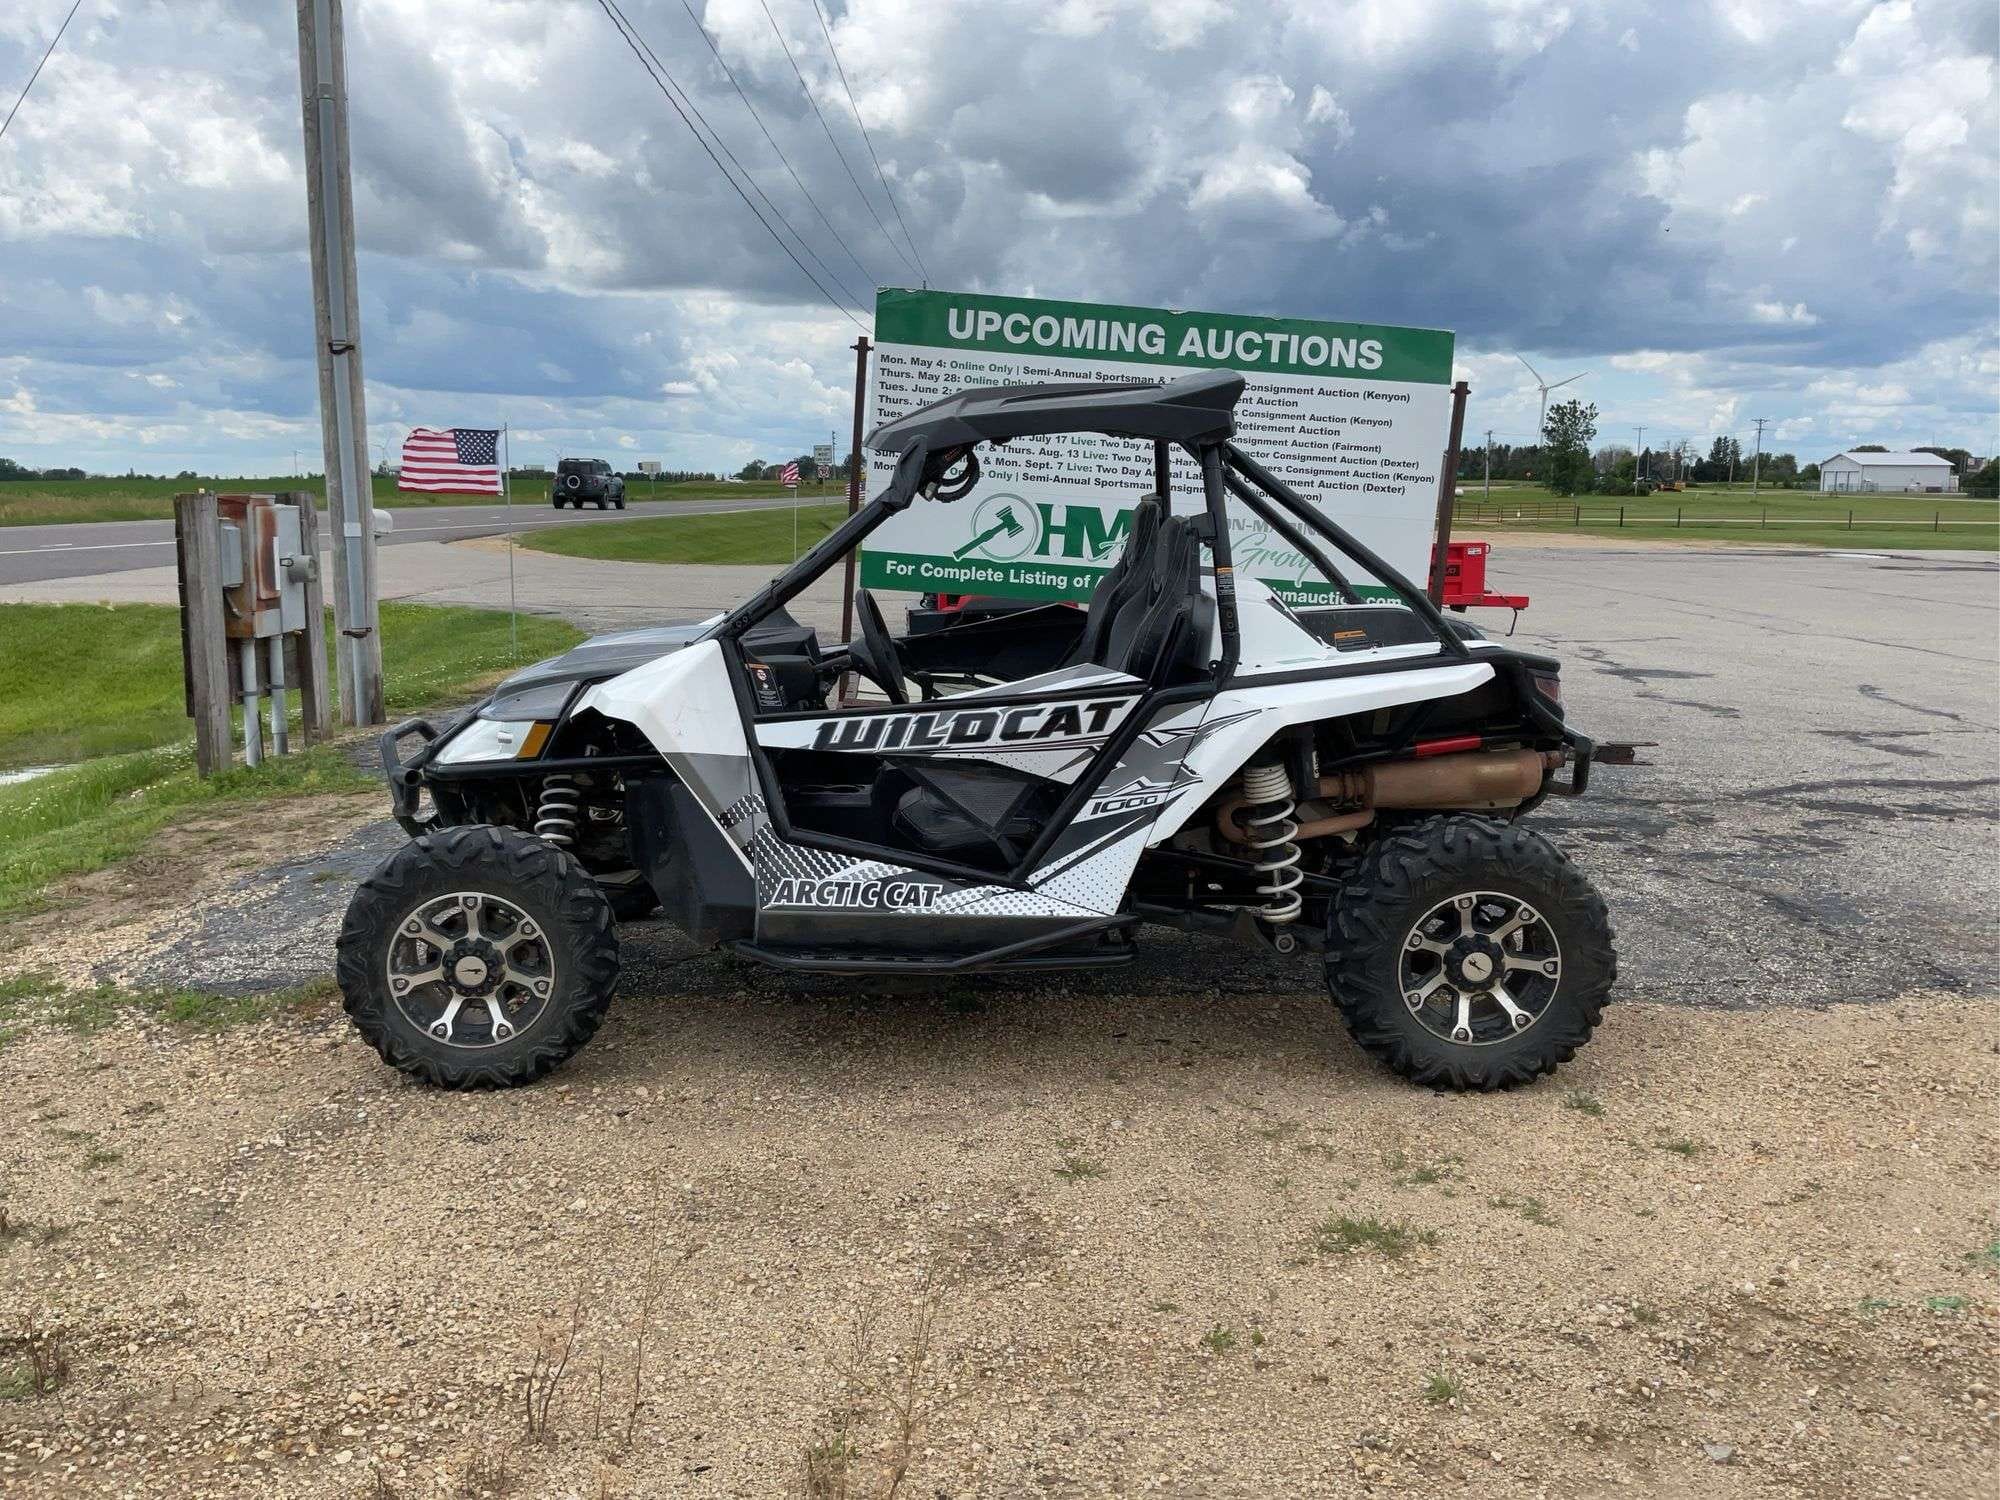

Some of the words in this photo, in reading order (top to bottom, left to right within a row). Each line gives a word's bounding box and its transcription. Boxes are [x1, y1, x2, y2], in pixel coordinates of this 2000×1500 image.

[947, 308, 1166, 355] UPCOMING
[1177, 327, 1383, 370] AUCTIONS
[880, 354, 906, 365] Mon.
[910, 357, 933, 368] May
[936, 360, 947, 369] 4:
[950, 361, 985, 372] Online
[989, 364, 1013, 375] Only
[1023, 366, 1092, 380] Semi-Annual
[1095, 371, 1154, 384] Sportsman
[1158, 376, 1166, 385] &
[1243, 383, 1314, 396] Consignment
[1318, 388, 1359, 398] Auction
[1362, 390, 1411, 403] (Kenyon)
[880, 368, 914, 379] Thurs.
[918, 371, 941, 383] May
[944, 373, 961, 383] 28:
[964, 375, 999, 386] Online
[1257, 398, 1298, 407] Auction
[878, 394, 912, 405] Thurs.
[1235, 421, 1295, 433] Retirement
[1299, 426, 1340, 436] Auction
[879, 381, 908, 391] Tues.
[912, 384, 938, 394] June
[942, 386, 952, 395] 2:
[1241, 409, 1306, 422] Consignment
[1309, 414, 1346, 423] Auction
[1350, 417, 1392, 428] (Kenyon)
[1002, 444, 1035, 455] Thurs.
[1038, 448, 1062, 459] Aug.
[1067, 449, 1079, 458] 13
[1083, 450, 1108, 461] Live:
[1112, 453, 1131, 463] Two
[1134, 455, 1152, 465] Day
[1286, 465, 1349, 478] Consignment
[1352, 470, 1390, 480] Auction
[1392, 472, 1435, 484] (Kenyon)
[1029, 435, 1051, 444] July
[1055, 436, 1067, 445] 17
[1071, 436, 1096, 446] Live:
[1100, 439, 1120, 448] Two
[1123, 441, 1141, 451] Day
[1273, 451, 1337, 464] Consignment
[1340, 456, 1377, 466] Auction
[1380, 459, 1419, 470] (Dexter)
[1291, 440, 1329, 449] Auction
[1332, 442, 1382, 454] (Fairmont)
[983, 456, 991, 465] &
[995, 457, 1021, 467] Mon.
[1025, 459, 1053, 470] Sept.
[1057, 461, 1064, 470] 7
[1067, 463, 1093, 473] Live:
[1096, 465, 1118, 475] Two
[1121, 467, 1141, 477] Day
[1318, 481, 1359, 491] Auction
[1362, 483, 1405, 496] (Dexter)
[989, 470, 1013, 481] Only
[1022, 472, 1090, 486] Semi-Annual
[1094, 478, 1153, 490] Sportsman
[886, 561, 915, 575] For
[920, 562, 1004, 582] Complete
[1010, 569, 1067, 589] Listing
[1073, 574, 1091, 588] of
[812, 700, 1131, 750] WILDCAT
[1090, 795, 1158, 815] 1000
[772, 878, 882, 908] ARCTIC
[885, 882, 943, 908] CAT
